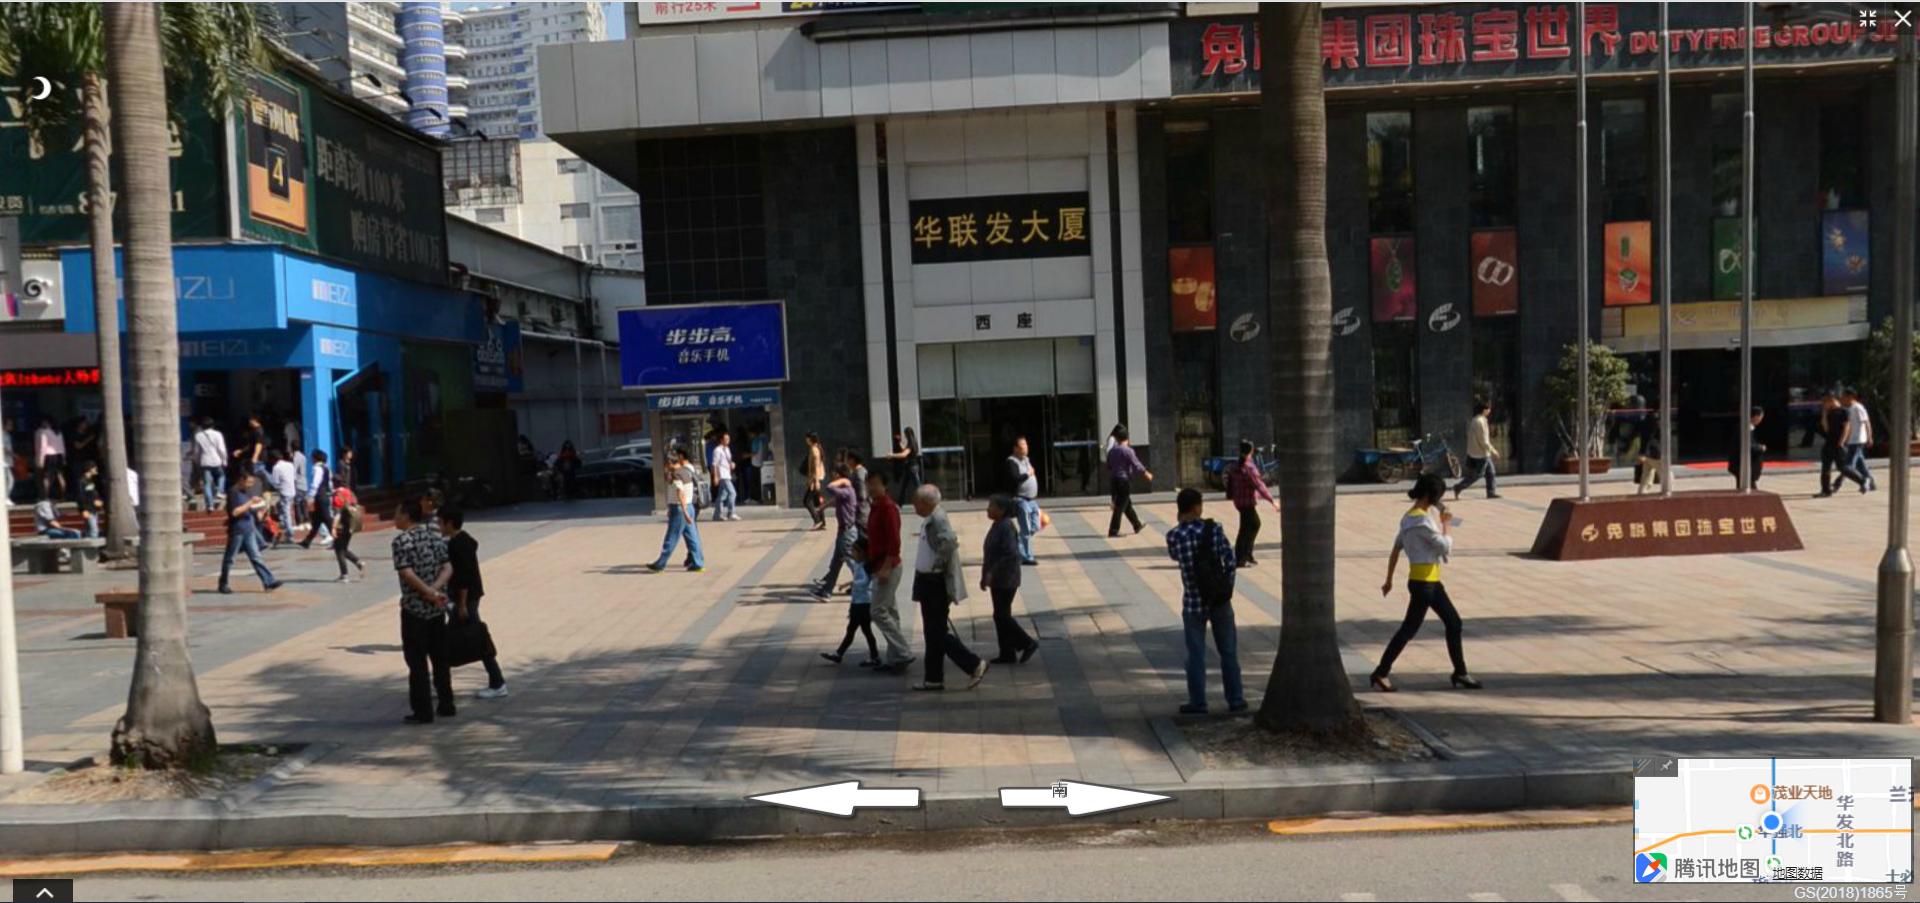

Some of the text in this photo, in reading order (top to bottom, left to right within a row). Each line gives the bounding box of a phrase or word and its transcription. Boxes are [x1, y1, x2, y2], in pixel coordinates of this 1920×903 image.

[1202, 6, 1621, 75] 免集团珠宝世界
[1630, 26, 1771, 54] DUTYFRE
[272, 156, 284, 186] 4
[914, 207, 1086, 248] 华联发大厦
[975, 312, 1032, 330] 西座
[678, 348, 730, 364] 音乐手机
[1606, 516, 1778, 540] 免税集团珠宝世界
